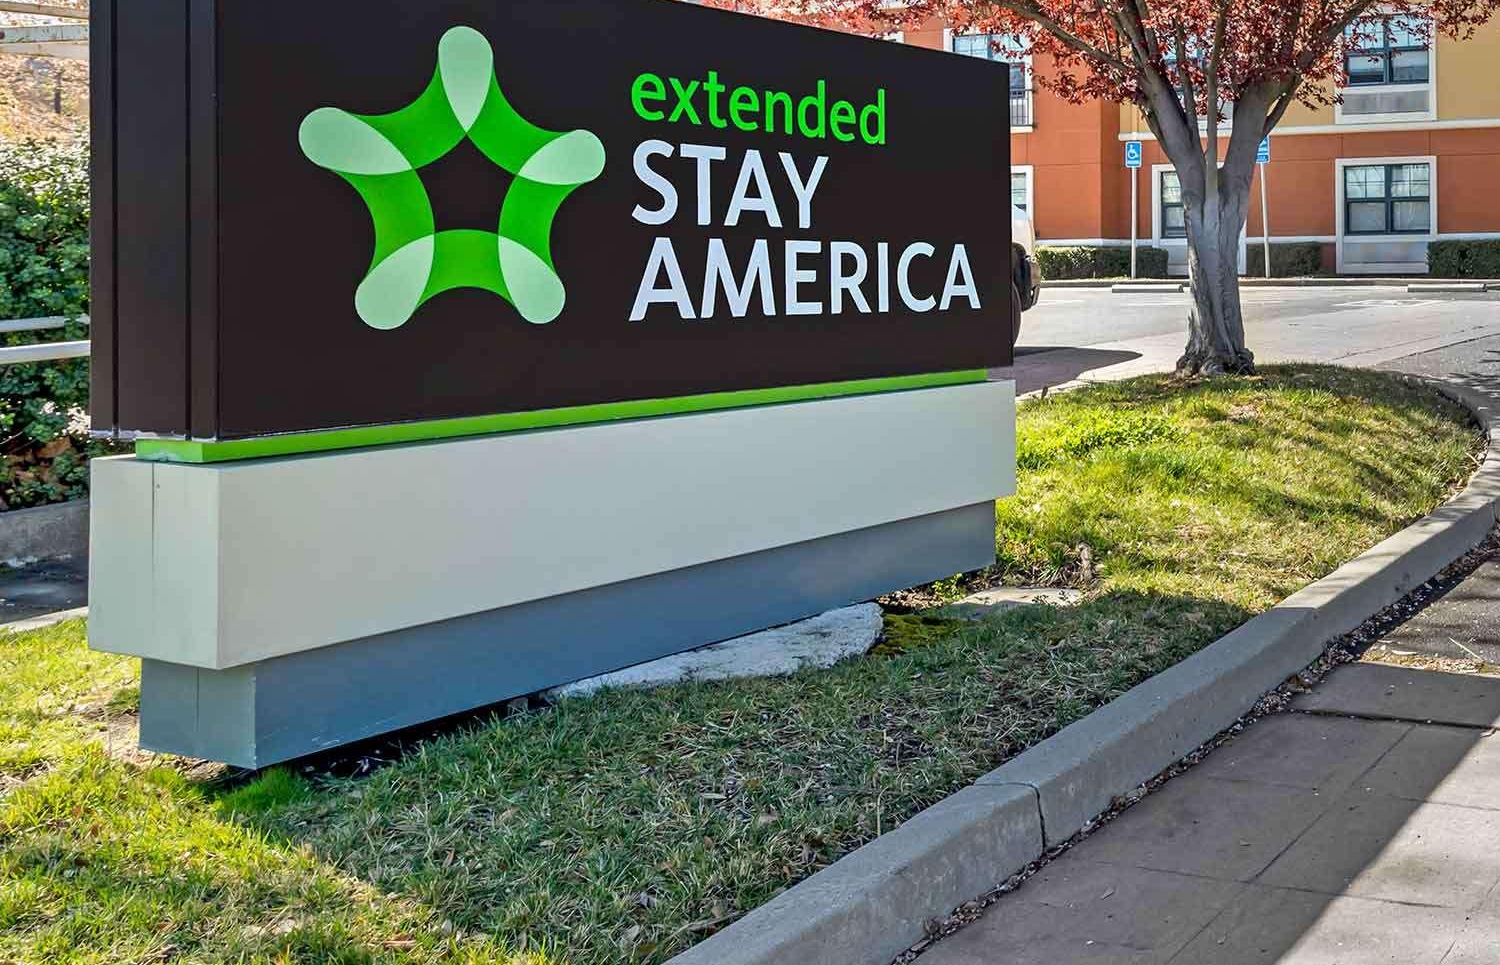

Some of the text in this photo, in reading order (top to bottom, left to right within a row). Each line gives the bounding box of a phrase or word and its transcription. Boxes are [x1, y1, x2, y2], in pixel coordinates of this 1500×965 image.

[630, 69, 886, 145] extended
[631, 139, 829, 229] STAY
[628, 236, 982, 322] AMERICA
